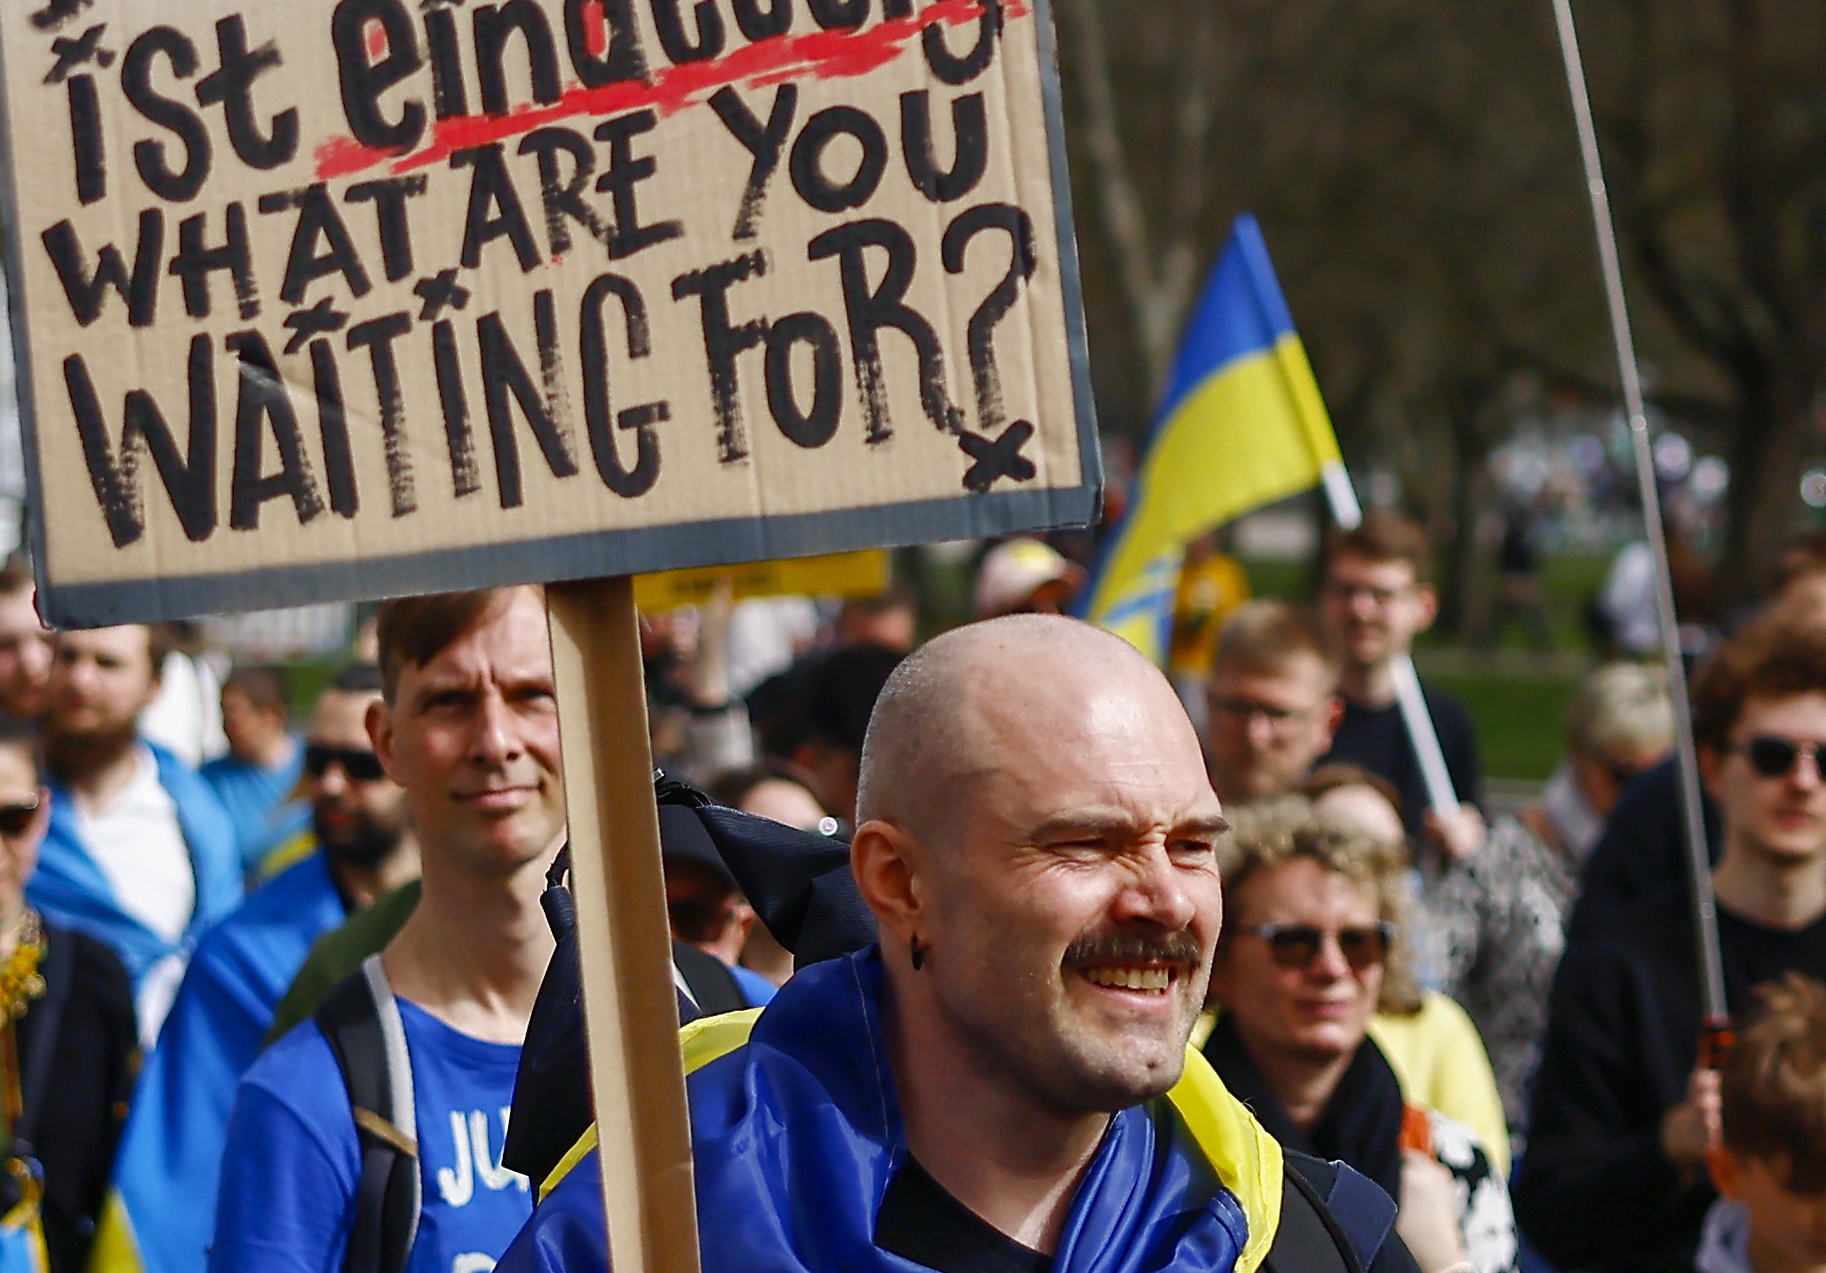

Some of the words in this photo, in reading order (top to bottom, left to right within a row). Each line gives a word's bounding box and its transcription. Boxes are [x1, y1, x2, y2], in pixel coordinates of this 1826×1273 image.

[42, 174, 428, 328] WHAT
[450, 111, 686, 273] ARE
[705, 84, 990, 241] YOU
